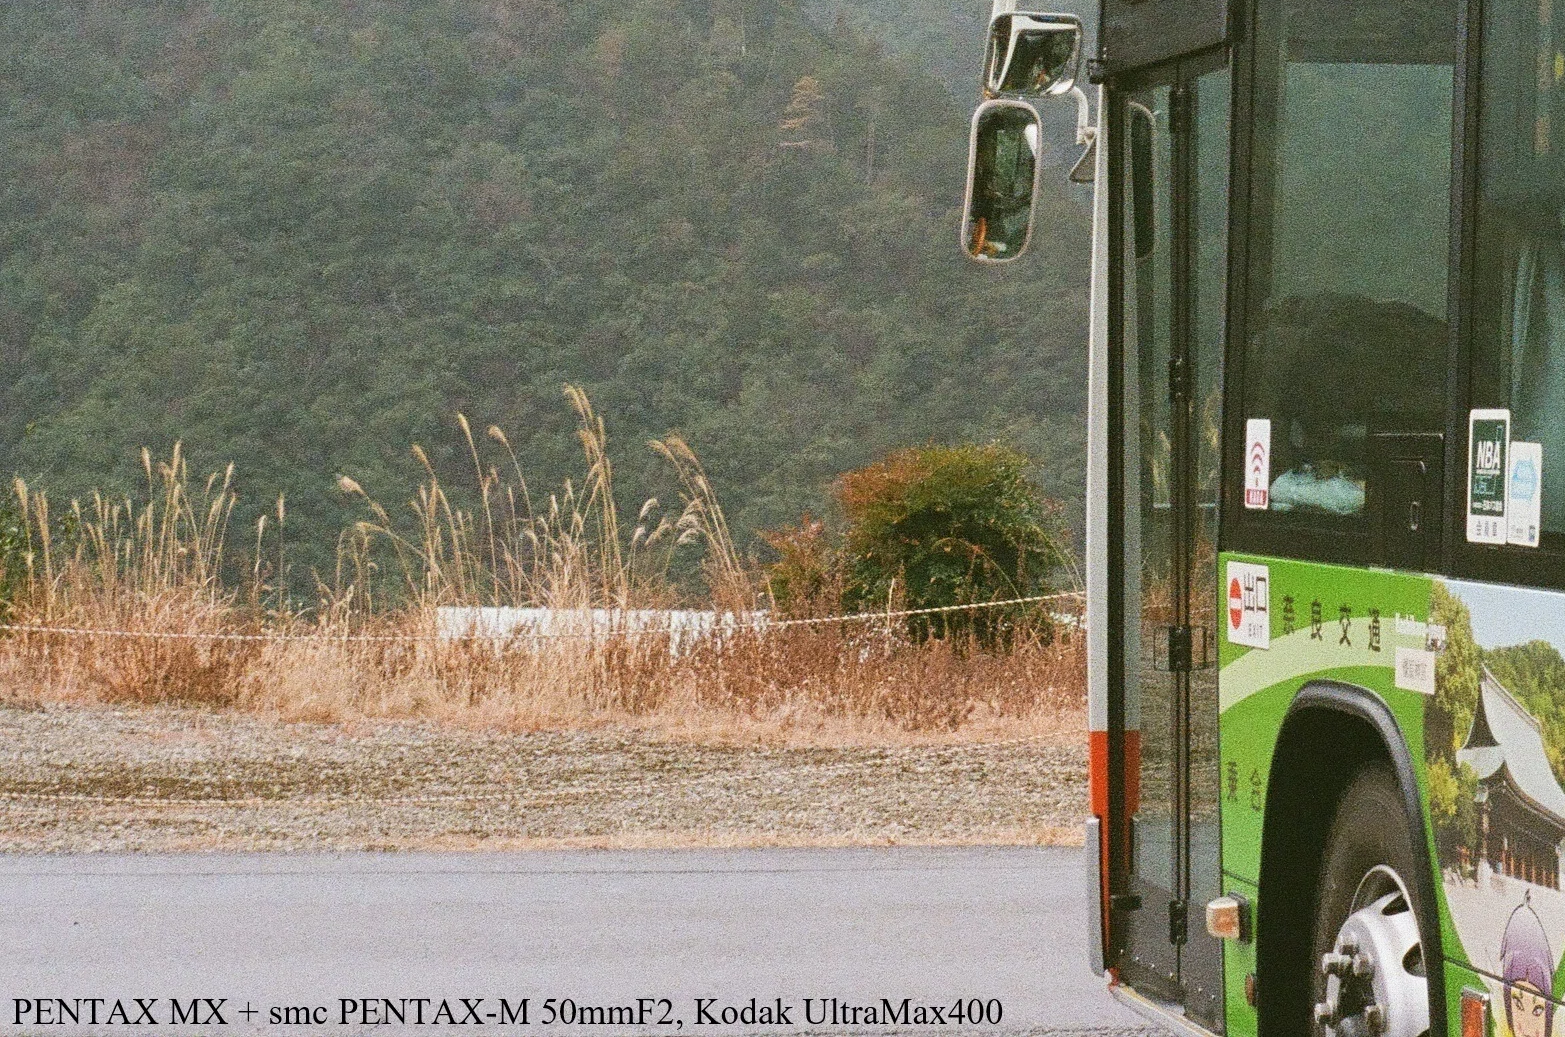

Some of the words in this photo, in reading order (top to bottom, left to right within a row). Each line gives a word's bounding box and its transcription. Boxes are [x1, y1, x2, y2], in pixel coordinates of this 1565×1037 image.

[1476, 440, 1501, 470] NBA
[1243, 572, 1268, 613] 出口
[1282, 594, 1381, 653] 奈良交通
